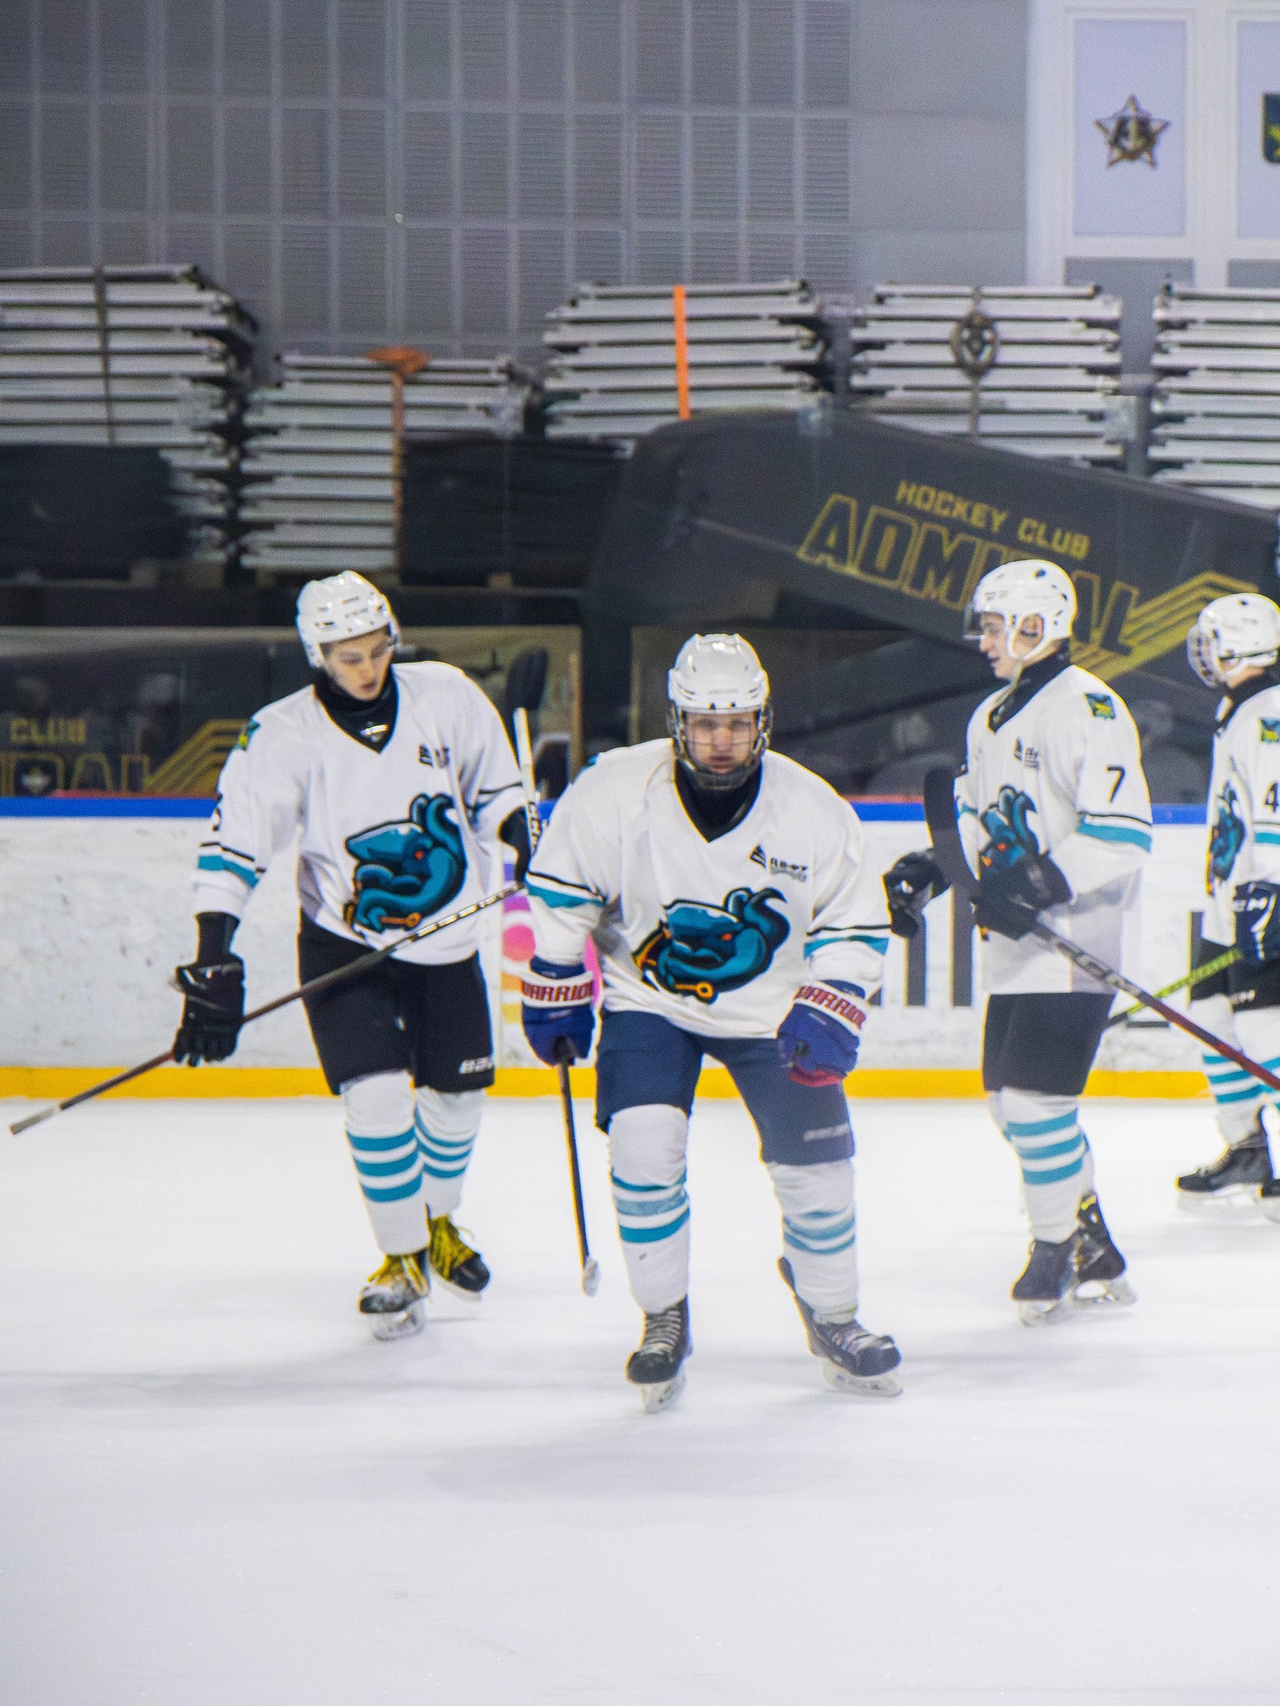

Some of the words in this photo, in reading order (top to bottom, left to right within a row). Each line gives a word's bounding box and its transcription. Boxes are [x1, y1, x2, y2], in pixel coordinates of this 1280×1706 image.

[895, 479, 1009, 534] HOCKEY
[1016, 517, 1092, 562] CLUB
[796, 492, 1141, 657] ADMAL
[1105, 764, 1127, 804] 7
[1263, 780, 1280, 814] 4
